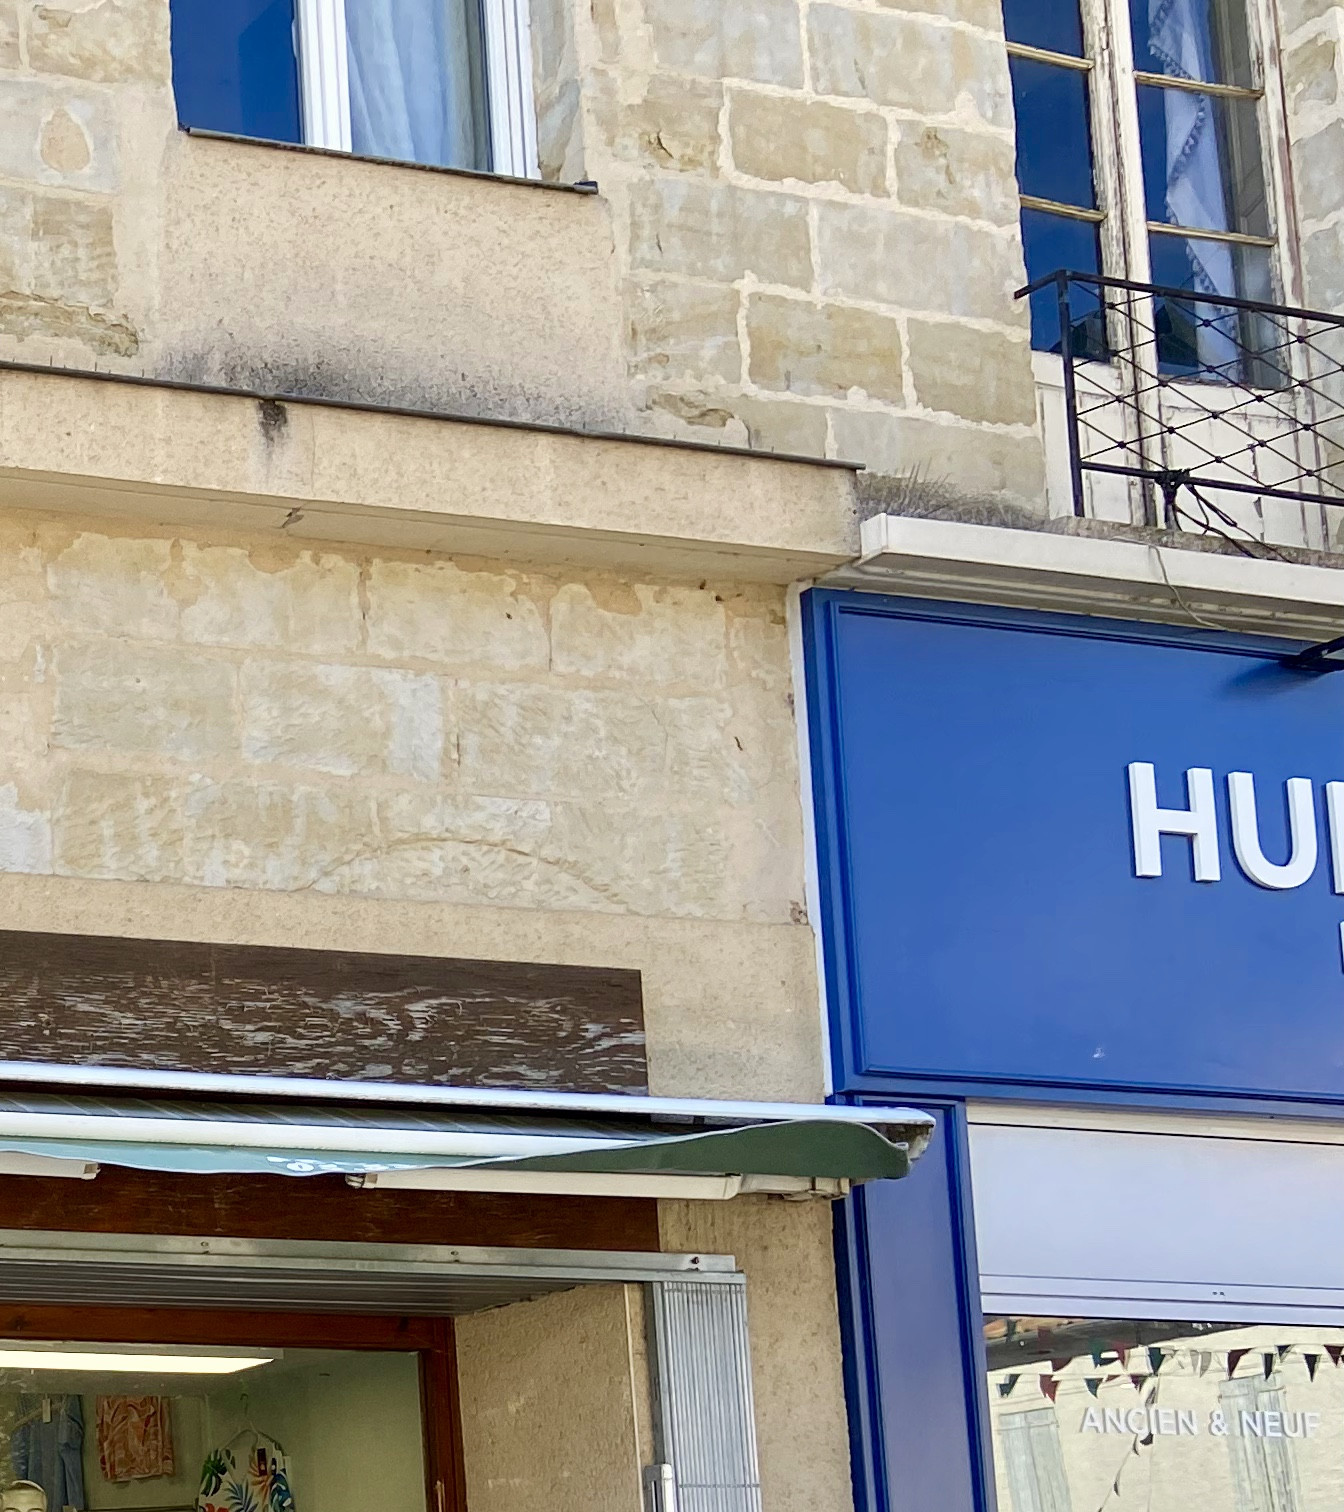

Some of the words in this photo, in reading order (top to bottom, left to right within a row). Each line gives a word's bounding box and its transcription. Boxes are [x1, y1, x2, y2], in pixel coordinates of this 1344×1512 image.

[1127, 761, 1344, 895] HU
[1079, 1406, 1198, 1437] ANCIEN
[1208, 1410, 1230, 1437] &
[1239, 1411, 1322, 1439] NEUF
